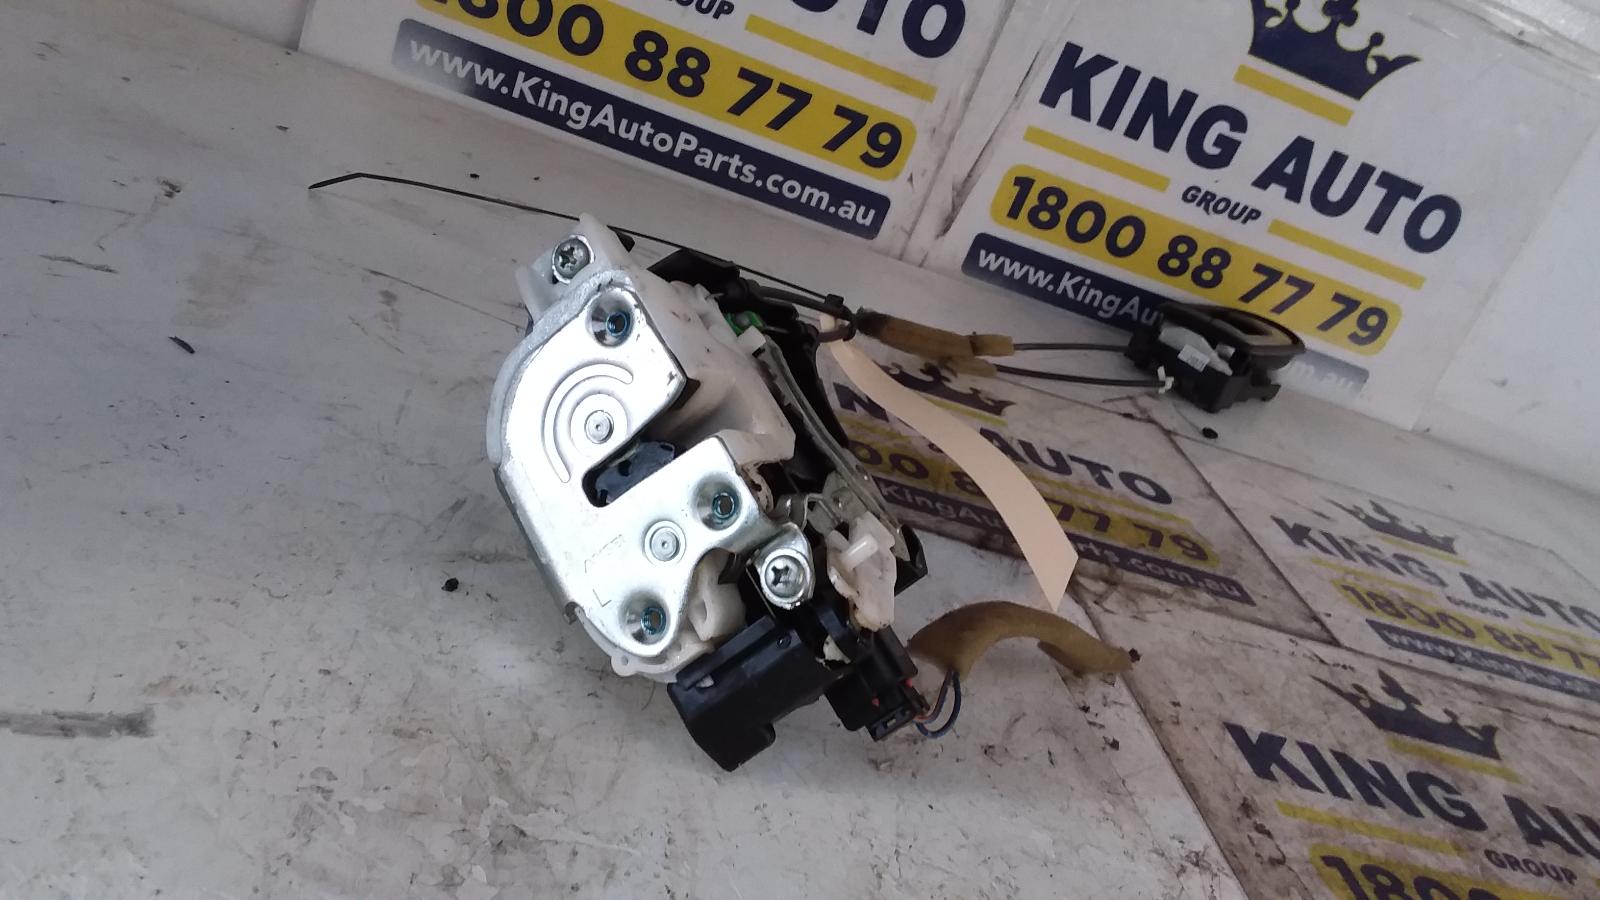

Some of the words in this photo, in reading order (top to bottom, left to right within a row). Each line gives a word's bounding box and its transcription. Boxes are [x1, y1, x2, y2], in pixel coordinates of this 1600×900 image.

[410, 40, 876, 228] www.KingAutoParts.com.au
[624, 29, 711, 98] 88
[726, 66, 813, 131] 77
[821, 105, 902, 169] 79
[1038, 41, 1249, 170] KING
[1251, 136, 1462, 254] AUTO
[1181, 185, 1262, 227] GROUP
[1006, 176, 1146, 258] 1800
[1157, 234, 1232, 289] 88
[1238, 262, 1316, 316] 77
[1315, 291, 1389, 347] 79
[1133, 522, 1209, 561] 79
[1270, 514, 1448, 588] KING
[1341, 584, 1476, 639] 1800
[1223, 721, 1488, 832] KING
[1502, 794, 1600, 863] AU
[1484, 848, 1578, 887] GROUP
